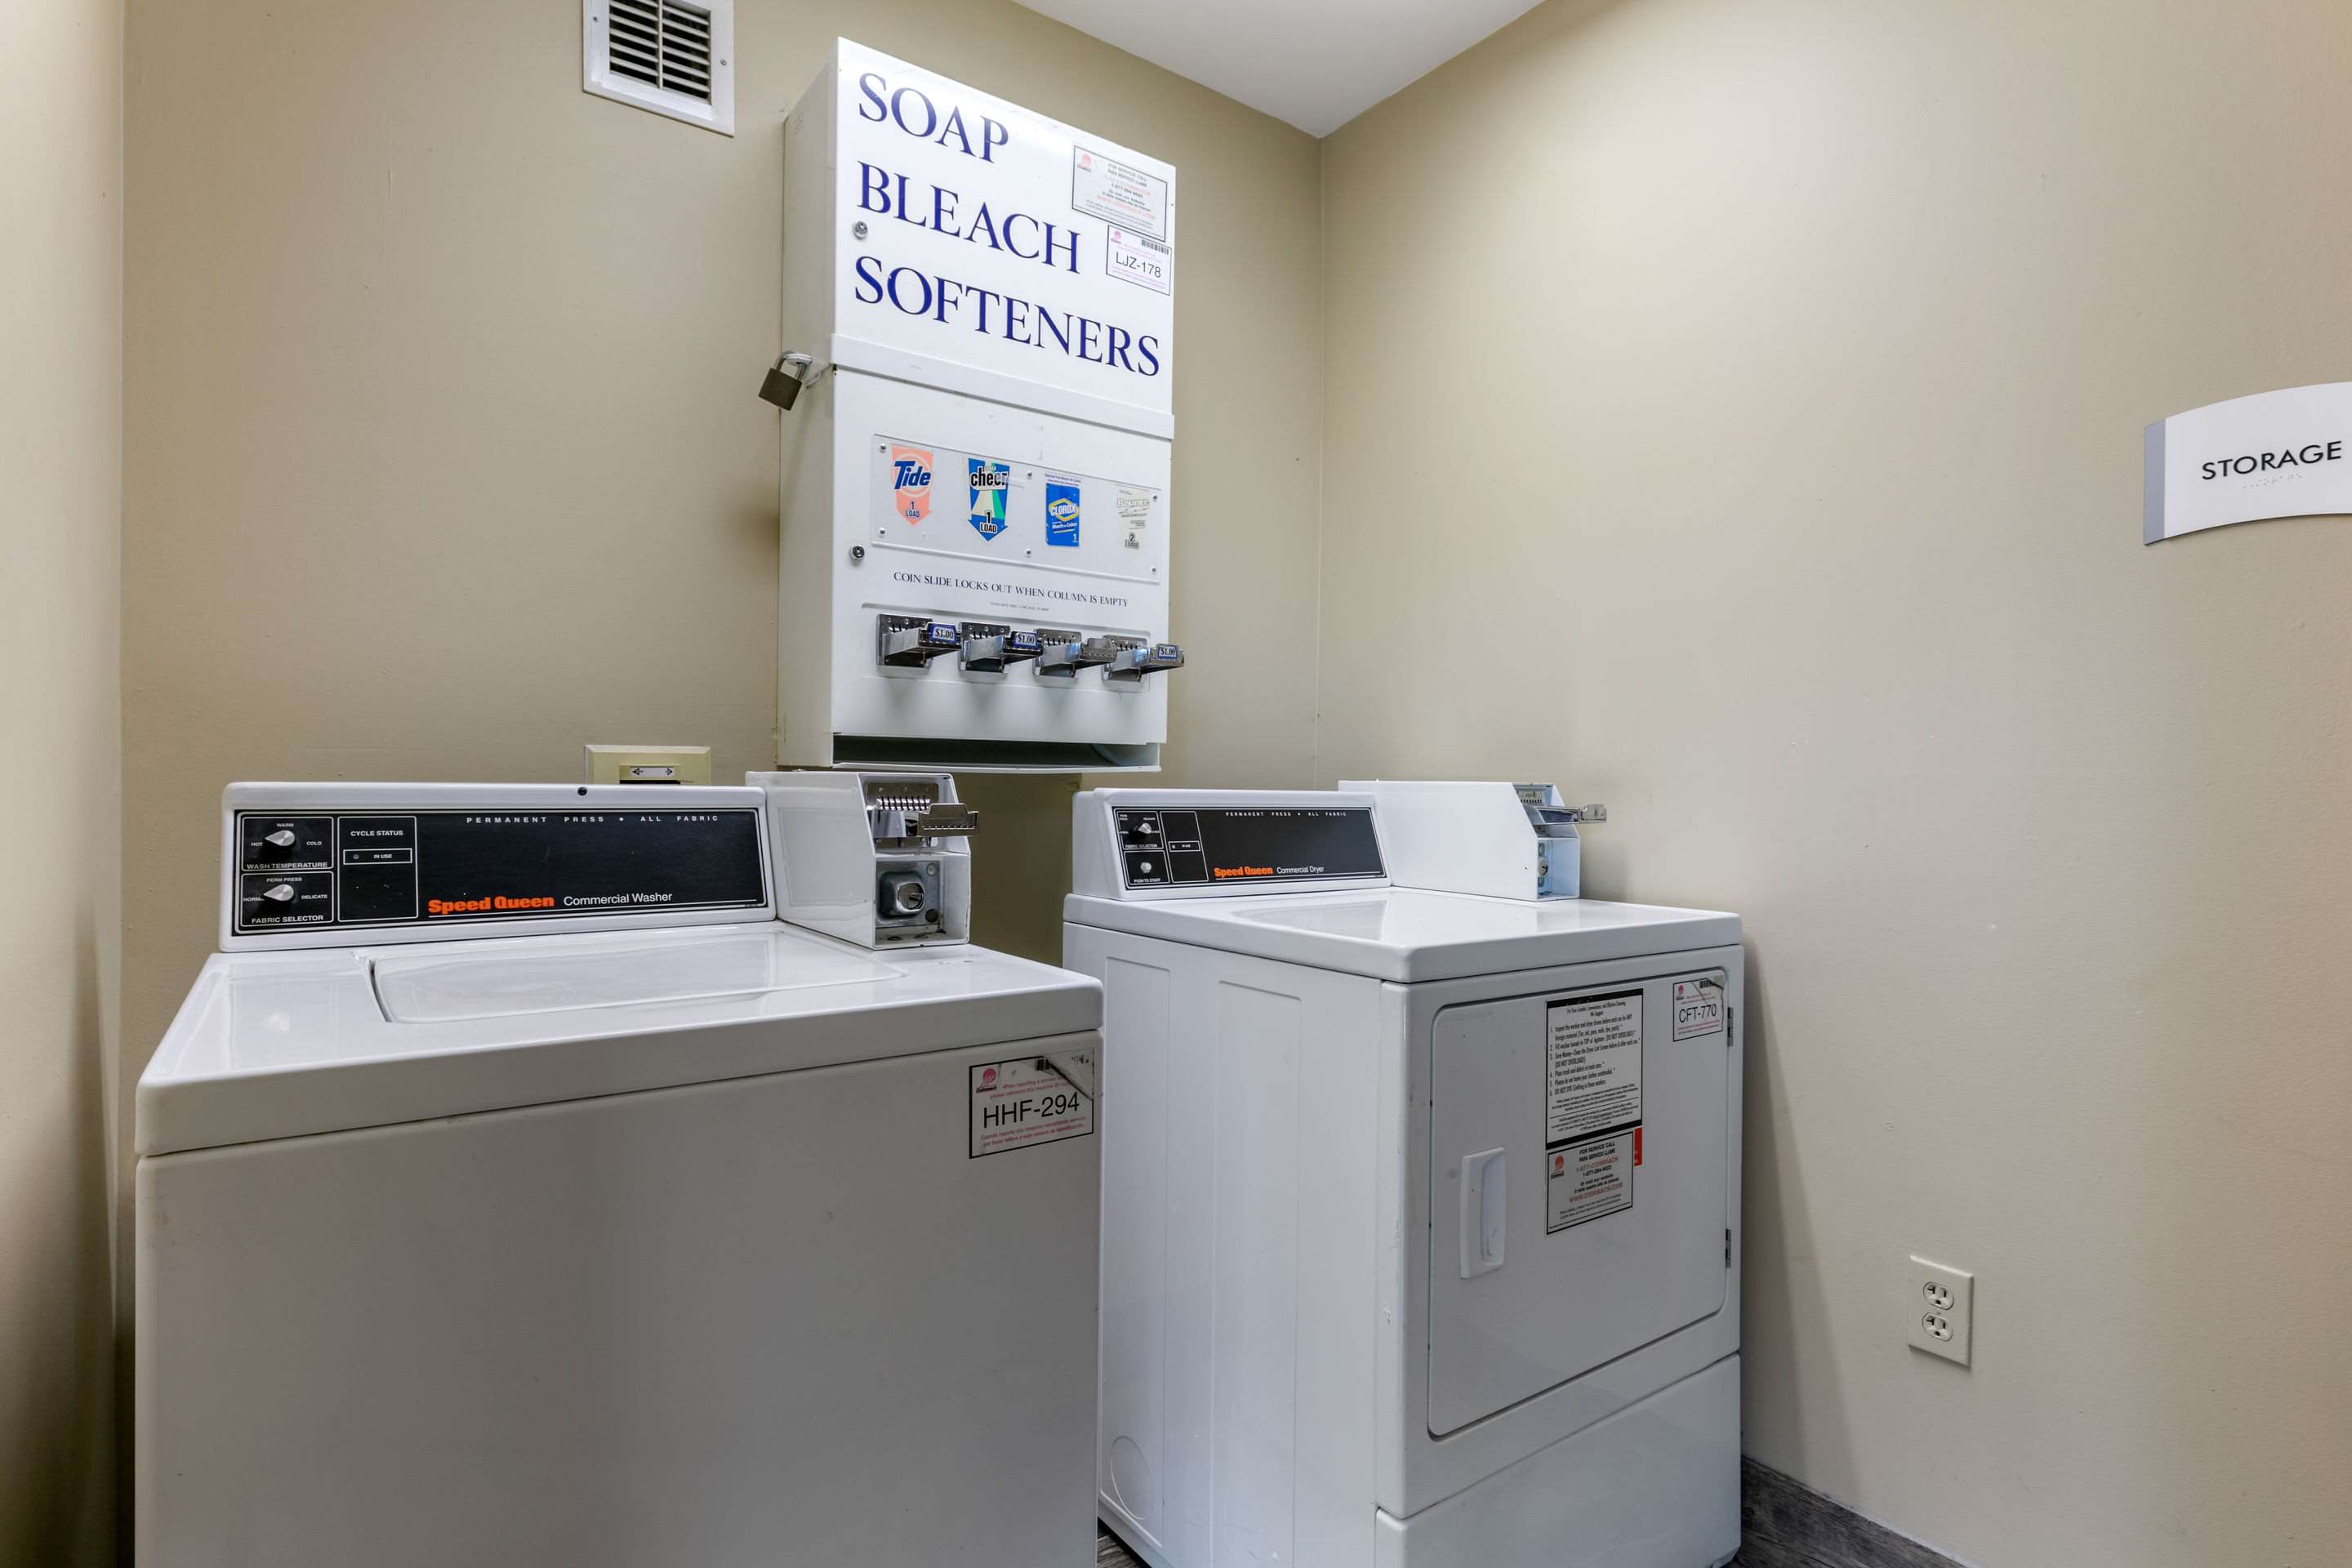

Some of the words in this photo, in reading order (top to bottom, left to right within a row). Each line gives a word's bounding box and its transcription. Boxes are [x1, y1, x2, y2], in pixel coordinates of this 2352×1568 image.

[858, 73, 1009, 163] SOAP
[857, 161, 1080, 274] BLEACH
[1116, 252, 1161, 278] LJZ-178
[854, 256, 1160, 376] SOFTENERS
[2202, 441, 2342, 479] STORAGE
[894, 461, 931, 490] Tide
[971, 466, 1007, 486] cheer
[911, 501, 915, 510] 1
[1051, 505, 1076, 516] CLOROX
[987, 511, 990, 523] 1
[981, 523, 997, 532] LOAD
[893, 572, 921, 584] COIN
[924, 576, 951, 587] SLIDE
[956, 579, 989, 590] LOCKS
[991, 583, 1012, 594] OUT
[1015, 586, 1045, 598] WHEN
[1048, 590, 1087, 602] COLUMN
[1089, 594, 1098, 604] IS
[1100, 596, 1129, 608] EMPTY
[935, 627, 954, 639] $1.00
[1018, 634, 1034, 645] $1.00
[1160, 647, 1176, 656] $1.00
[1214, 866, 1243, 878] Speed
[1245, 866, 1273, 875] Queen
[429, 898, 491, 915] Speed
[494, 896, 555, 910] Queen
[564, 894, 630, 906] Commercial
[632, 892, 672, 903] Washer
[1679, 1004, 1717, 1022] CFT-770
[983, 1092, 1080, 1128] HHF-294
